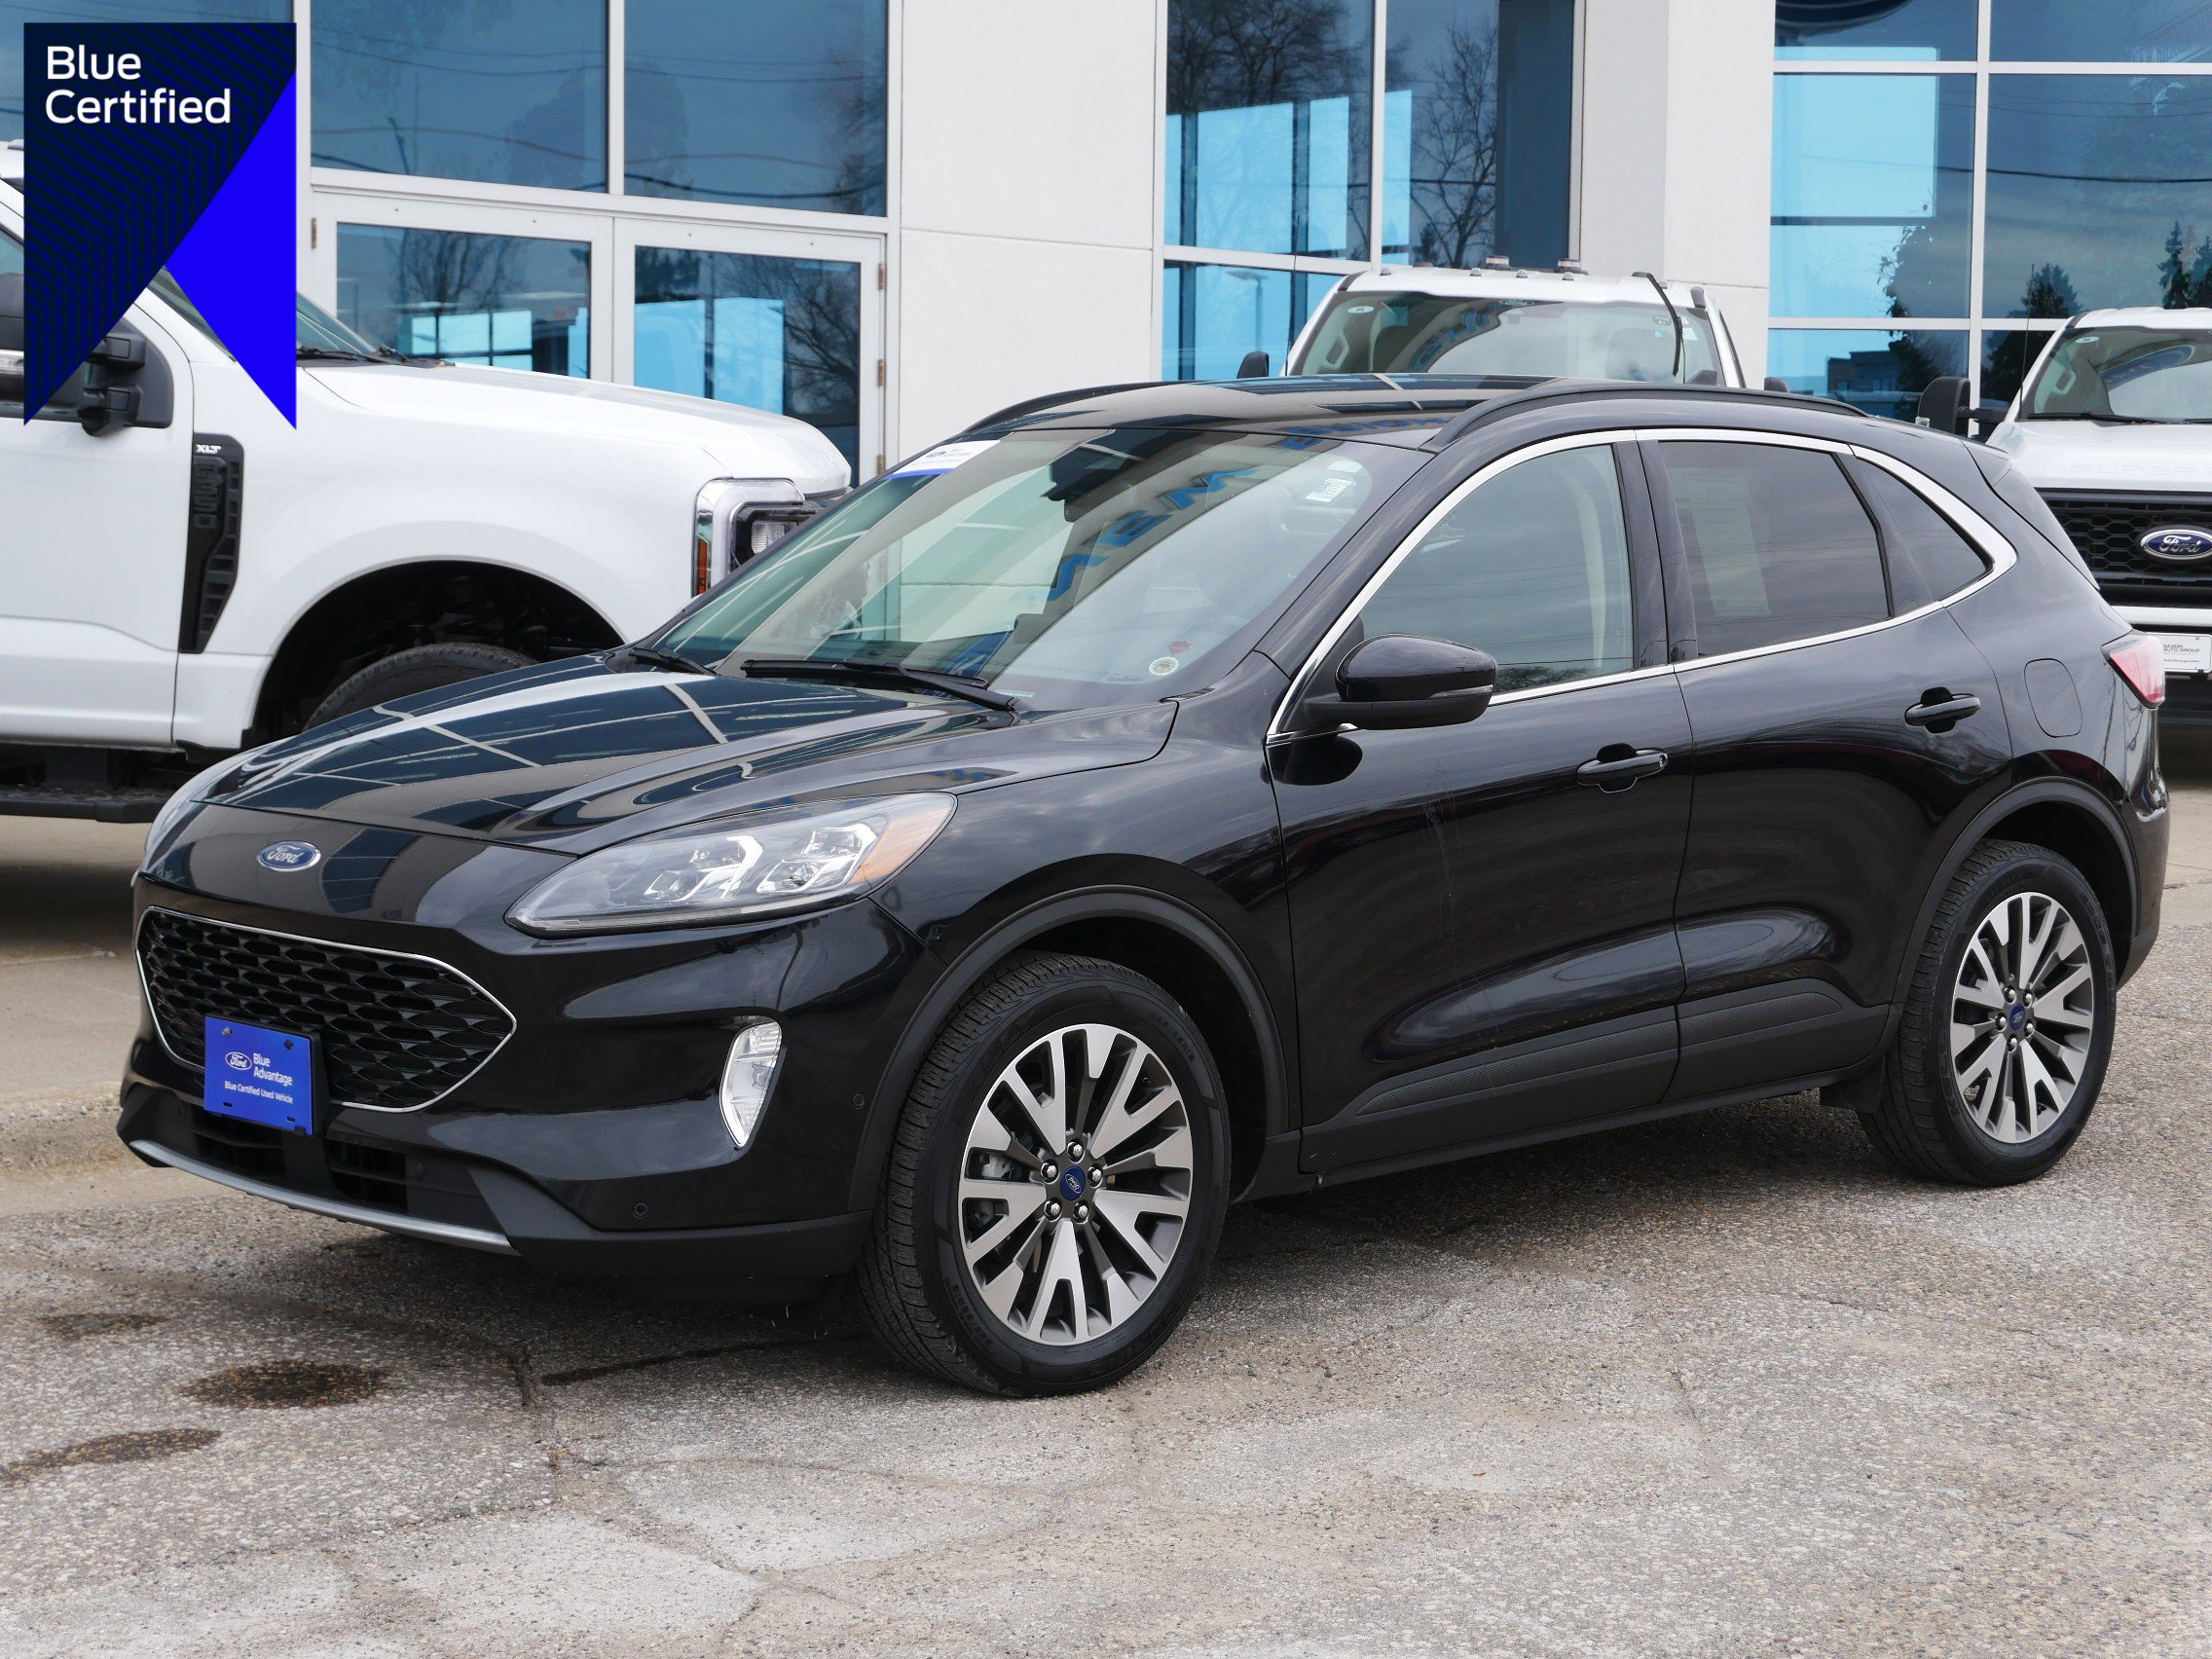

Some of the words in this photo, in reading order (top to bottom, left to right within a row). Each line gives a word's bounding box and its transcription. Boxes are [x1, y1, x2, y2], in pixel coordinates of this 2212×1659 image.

[196, 444, 222, 454] XLT
[2158, 535, 2201, 553] Ford
[267, 844, 306, 865] Ford
[230, 1053, 247, 1067] Ford
[253, 1052, 271, 1067] Blue
[253, 1066, 292, 1087] Advantage
[224, 1080, 238, 1090] Blue
[238, 1083, 261, 1096] Certified
[261, 1088, 275, 1099] Used
[275, 1091, 293, 1104] Vehicle
